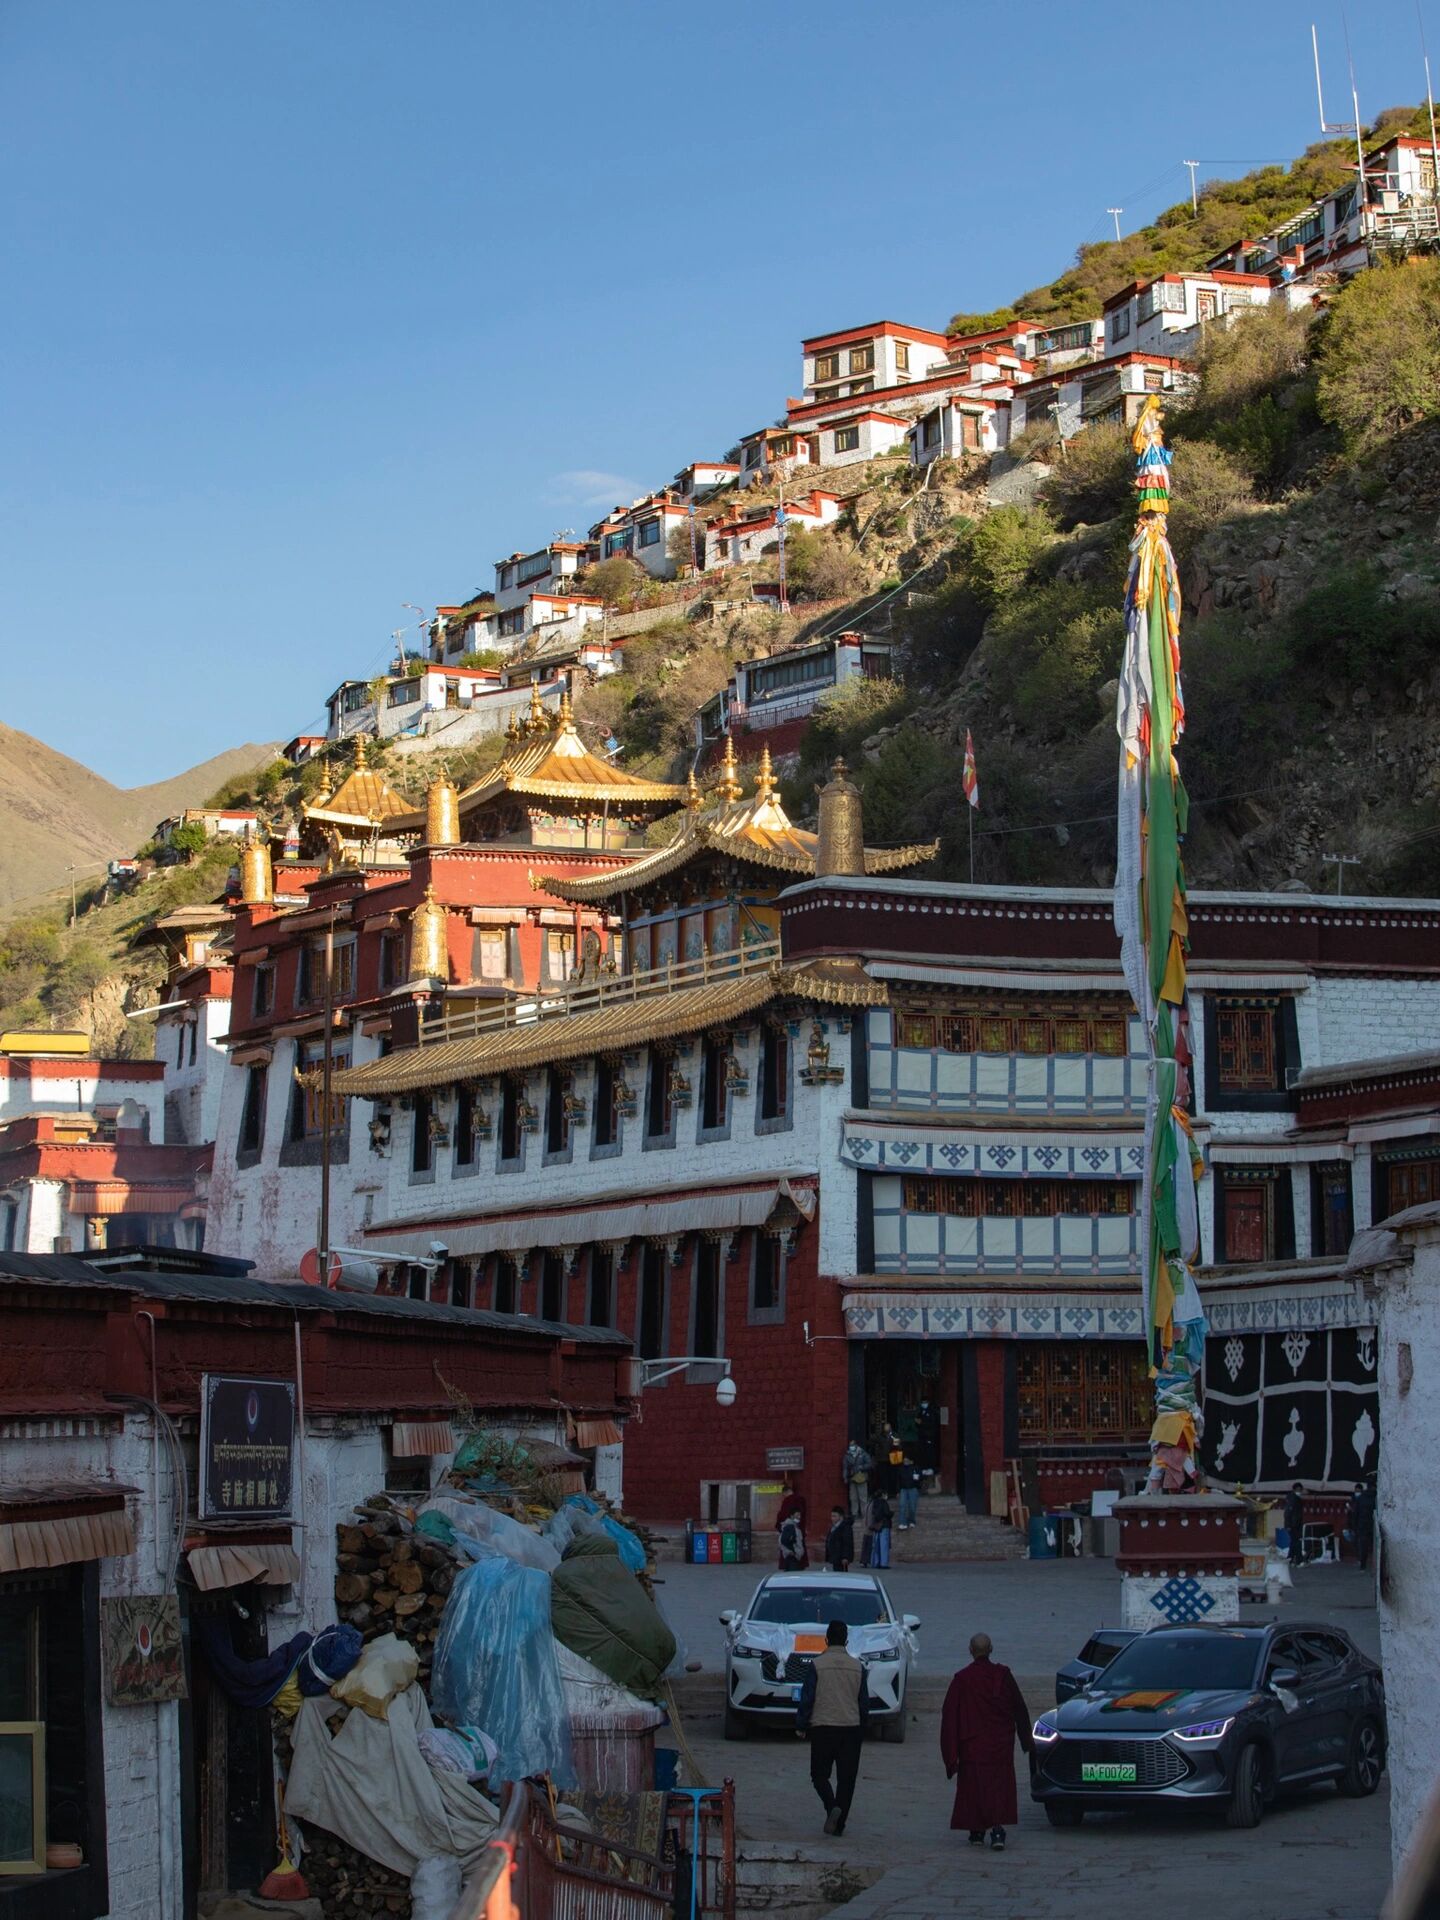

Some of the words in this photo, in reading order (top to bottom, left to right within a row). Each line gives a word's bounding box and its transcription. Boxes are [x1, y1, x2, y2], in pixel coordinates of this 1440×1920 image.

[222, 1479, 278, 1507] 寺庙捐赠处
